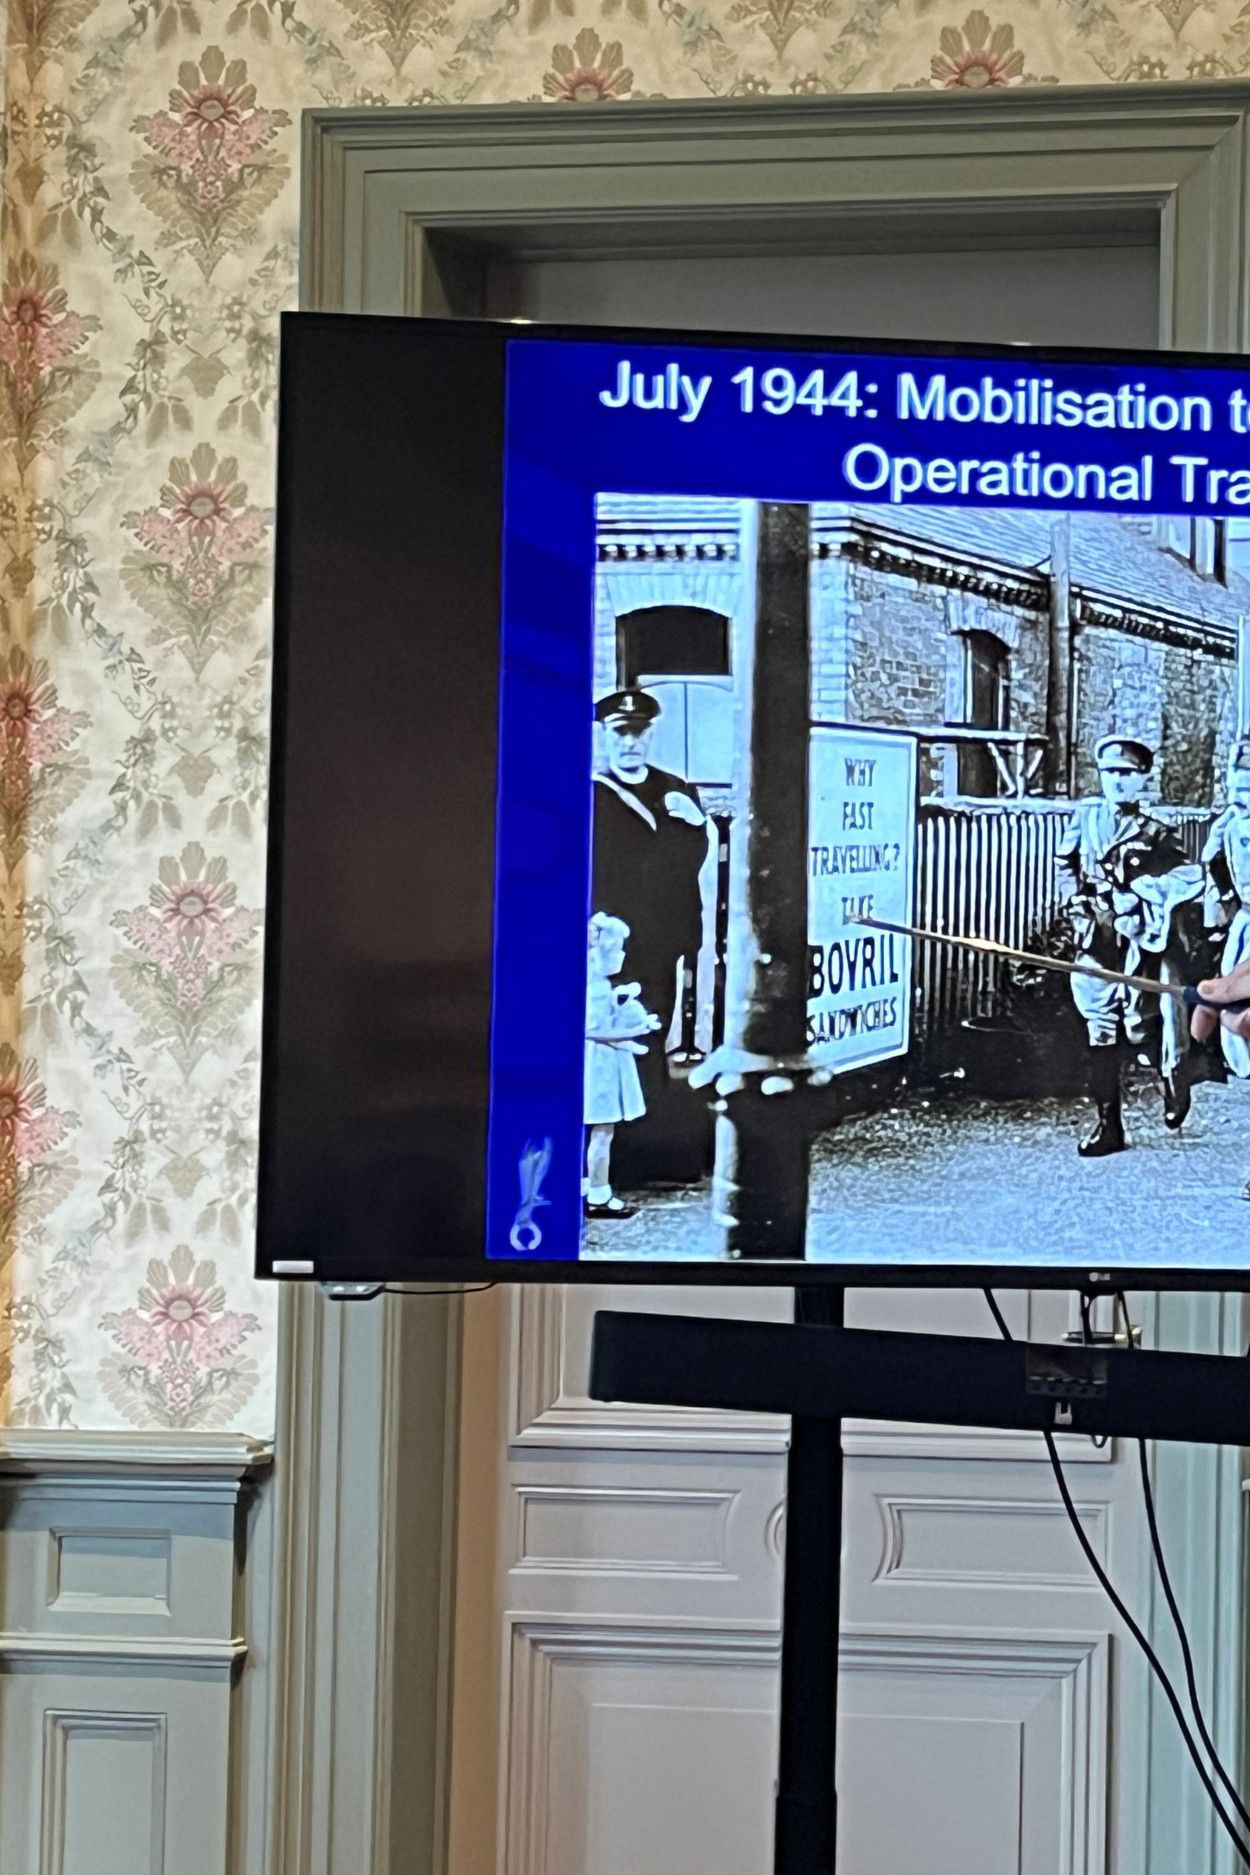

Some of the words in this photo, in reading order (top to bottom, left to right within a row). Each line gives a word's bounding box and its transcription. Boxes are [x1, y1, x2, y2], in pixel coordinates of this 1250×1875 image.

[600, 360, 712, 422] July
[731, 366, 878, 418] 1944:
[897, 372, 1212, 431] Mobilisation
[843, 442, 1152, 502] Operational
[844, 757, 877, 787] WHY
[842, 801, 874, 831] FAST
[811, 843, 900, 876] TRAVELLING?
[809, 933, 899, 1000] BOVRIL
